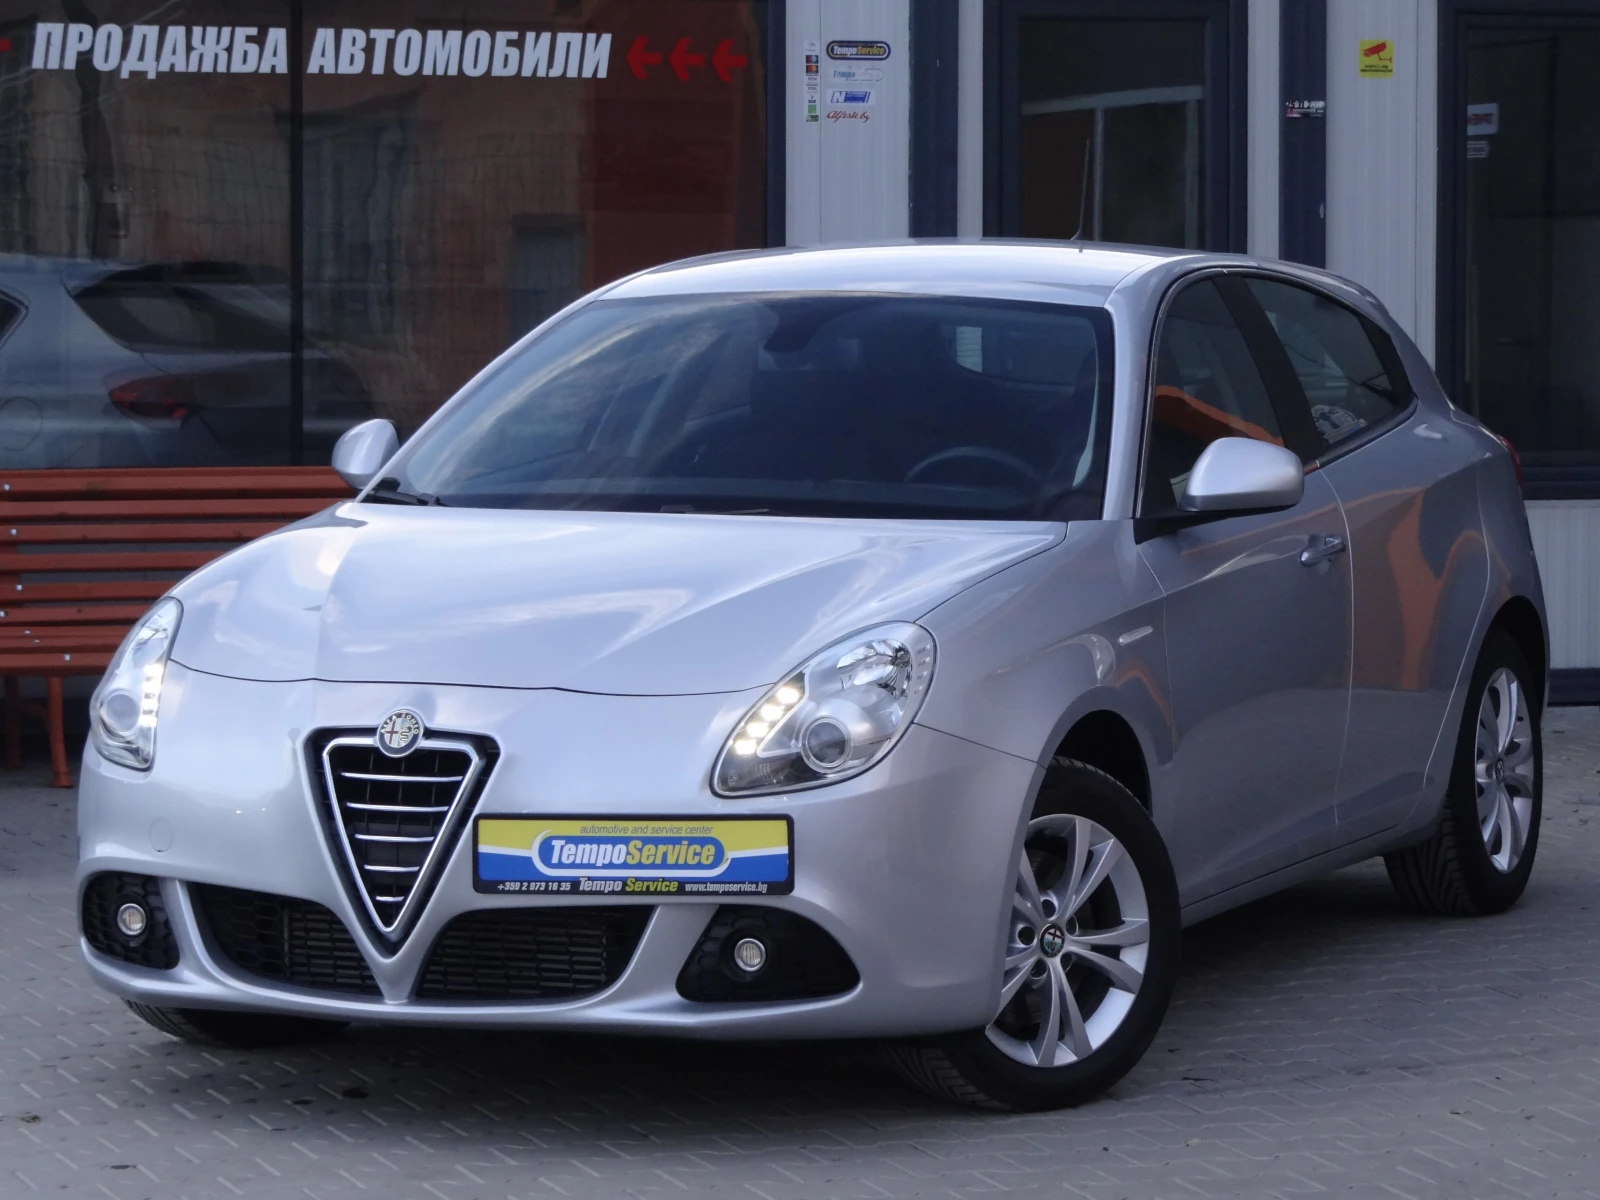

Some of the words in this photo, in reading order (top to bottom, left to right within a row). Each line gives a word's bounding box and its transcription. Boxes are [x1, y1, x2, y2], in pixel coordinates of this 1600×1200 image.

[31, 22, 288, 79] ПРОДАЖБА
[306, 27, 612, 79] АВТОМОБИЛИ
[380, 715, 397, 734] ALFA
[401, 713, 420, 735] ROMEO
[580, 825, 629, 835] automotive
[631, 825, 649, 835] and
[651, 825, 682, 835] service
[685, 826, 714, 835] center
[551, 839, 716, 867] TempoService
[497, 881, 520, 891] +359
[521, 882, 528, 891] 2
[529, 882, 546, 891] 973
[548, 882, 558, 891] 16
[560, 882, 572, 891] 35
[579, 877, 623, 893] Tempo
[625, 877, 679, 892] Service
[685, 881, 768, 894] www.temposervice.bg
